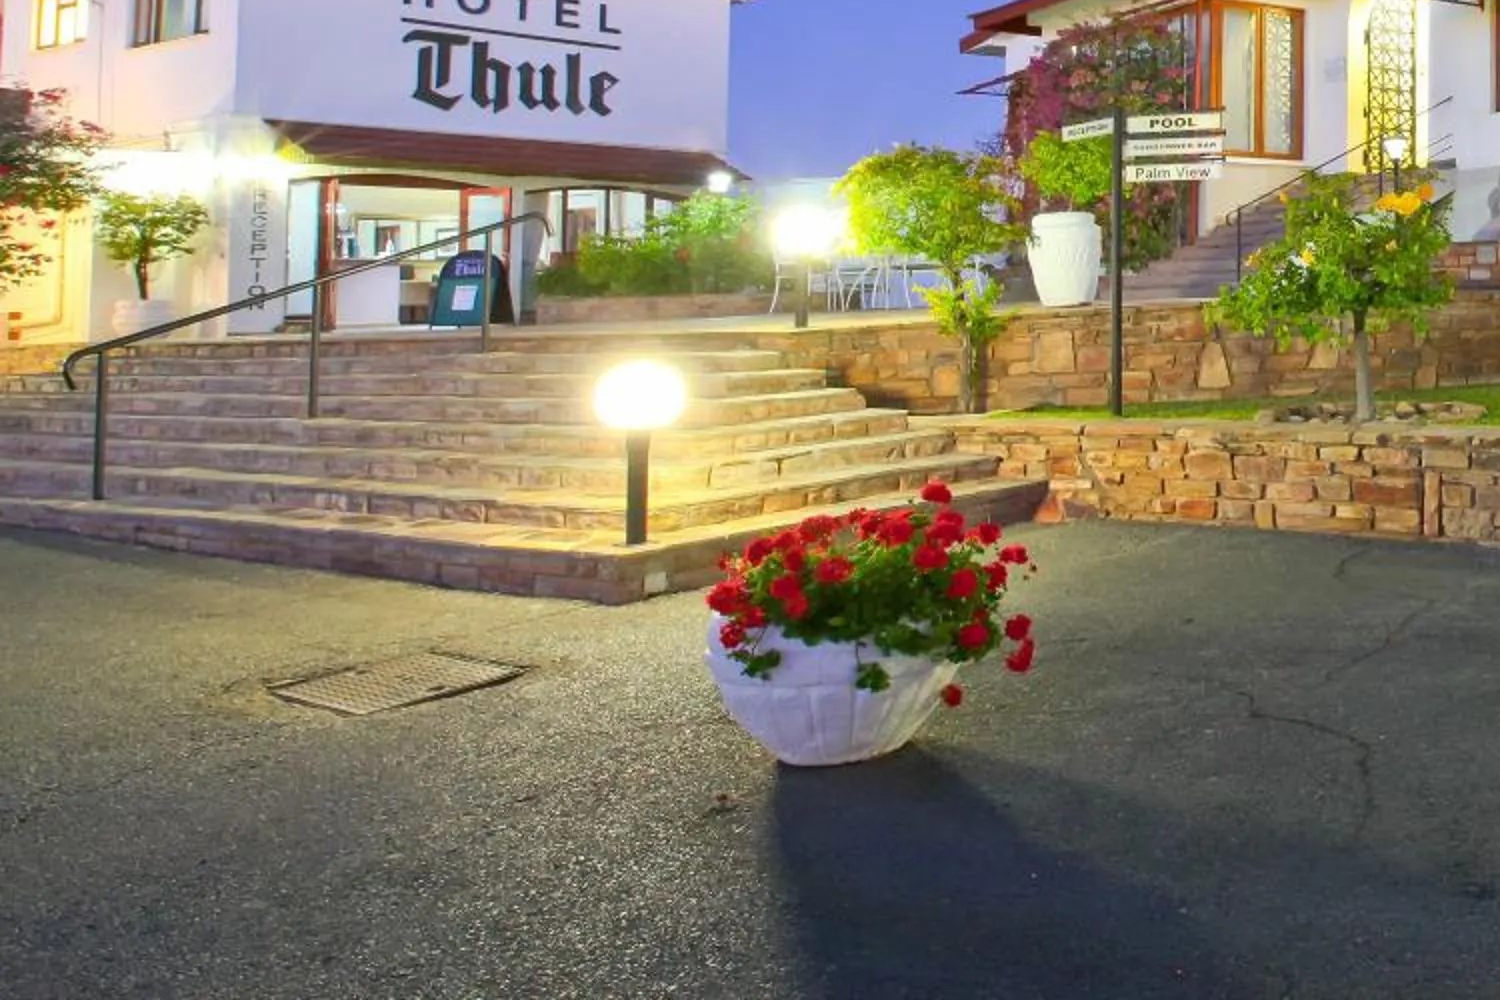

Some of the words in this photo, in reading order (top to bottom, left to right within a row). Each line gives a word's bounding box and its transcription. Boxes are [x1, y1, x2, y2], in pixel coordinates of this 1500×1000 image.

[402, 29, 620, 117] Thule
[1149, 117, 1197, 129] POOL
[1135, 167, 1171, 179] Palm
[1176, 167, 1211, 178] View
